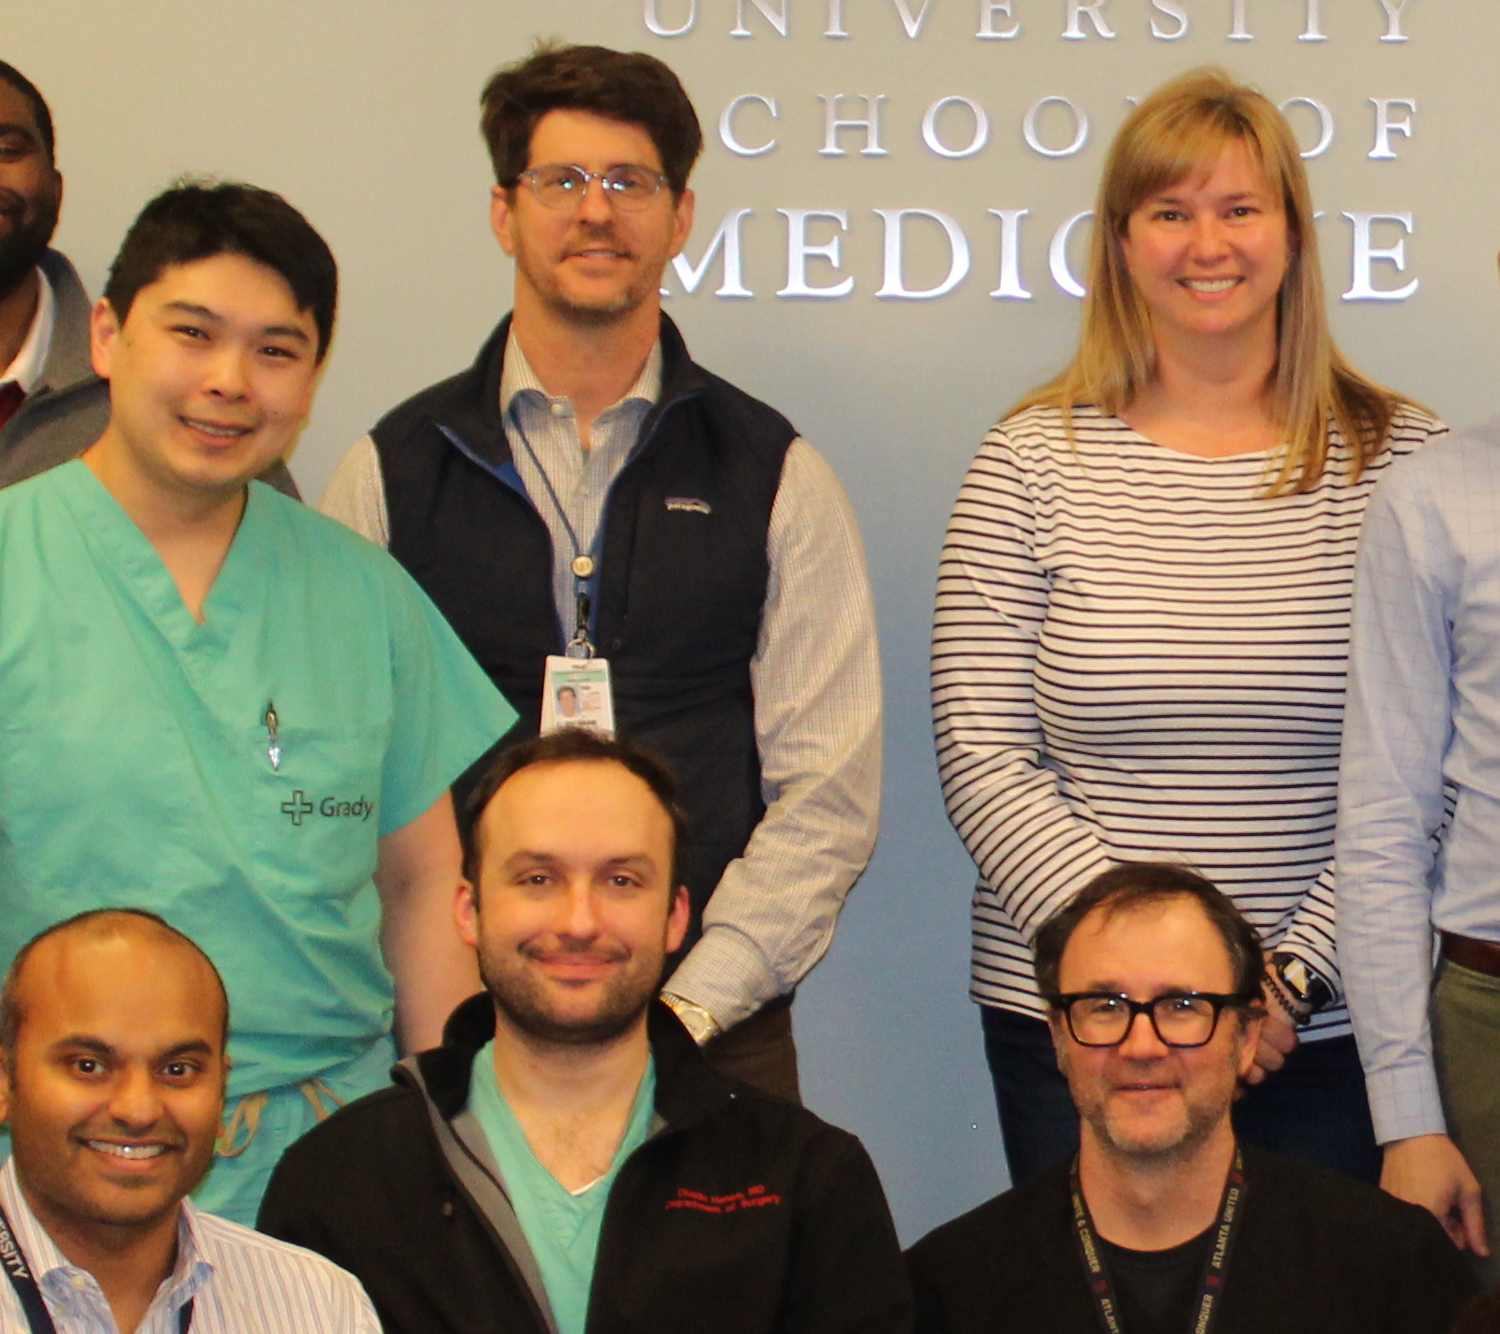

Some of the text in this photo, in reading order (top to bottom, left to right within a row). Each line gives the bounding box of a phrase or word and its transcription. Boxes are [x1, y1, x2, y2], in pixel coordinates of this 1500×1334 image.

[716, 94, 1416, 160] CHOO OF
[658, 207, 1420, 302] MEDICE
[320, 794, 374, 823] Grady
[1211, 1224, 1231, 1269] ATLANTA
[1224, 1188, 1239, 1223] UNITED
